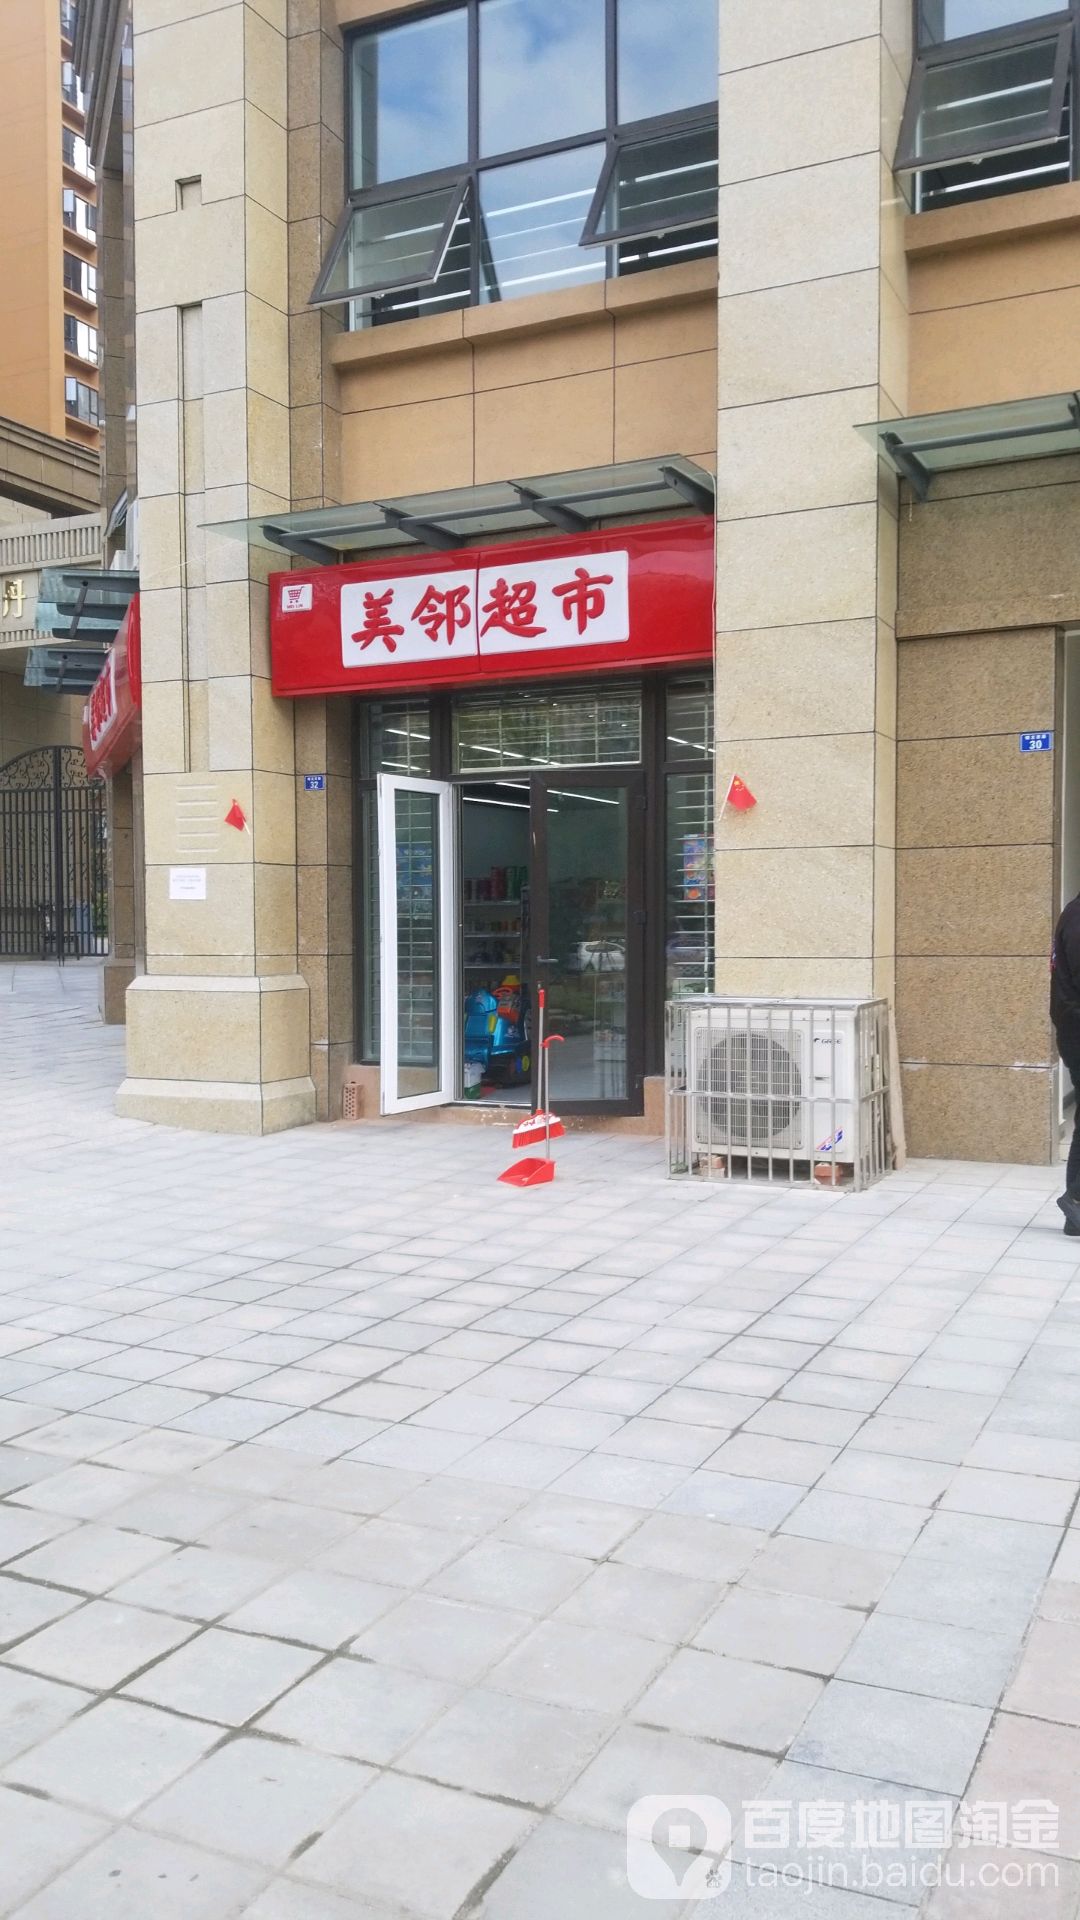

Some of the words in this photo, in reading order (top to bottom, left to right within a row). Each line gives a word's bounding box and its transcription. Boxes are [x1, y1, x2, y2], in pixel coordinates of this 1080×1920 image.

[3, 579, 26, 618] 丹
[351, 567, 613, 653] 美邻超市
[1029, 740, 1042, 749] 30
[310, 781, 319, 789] 32
